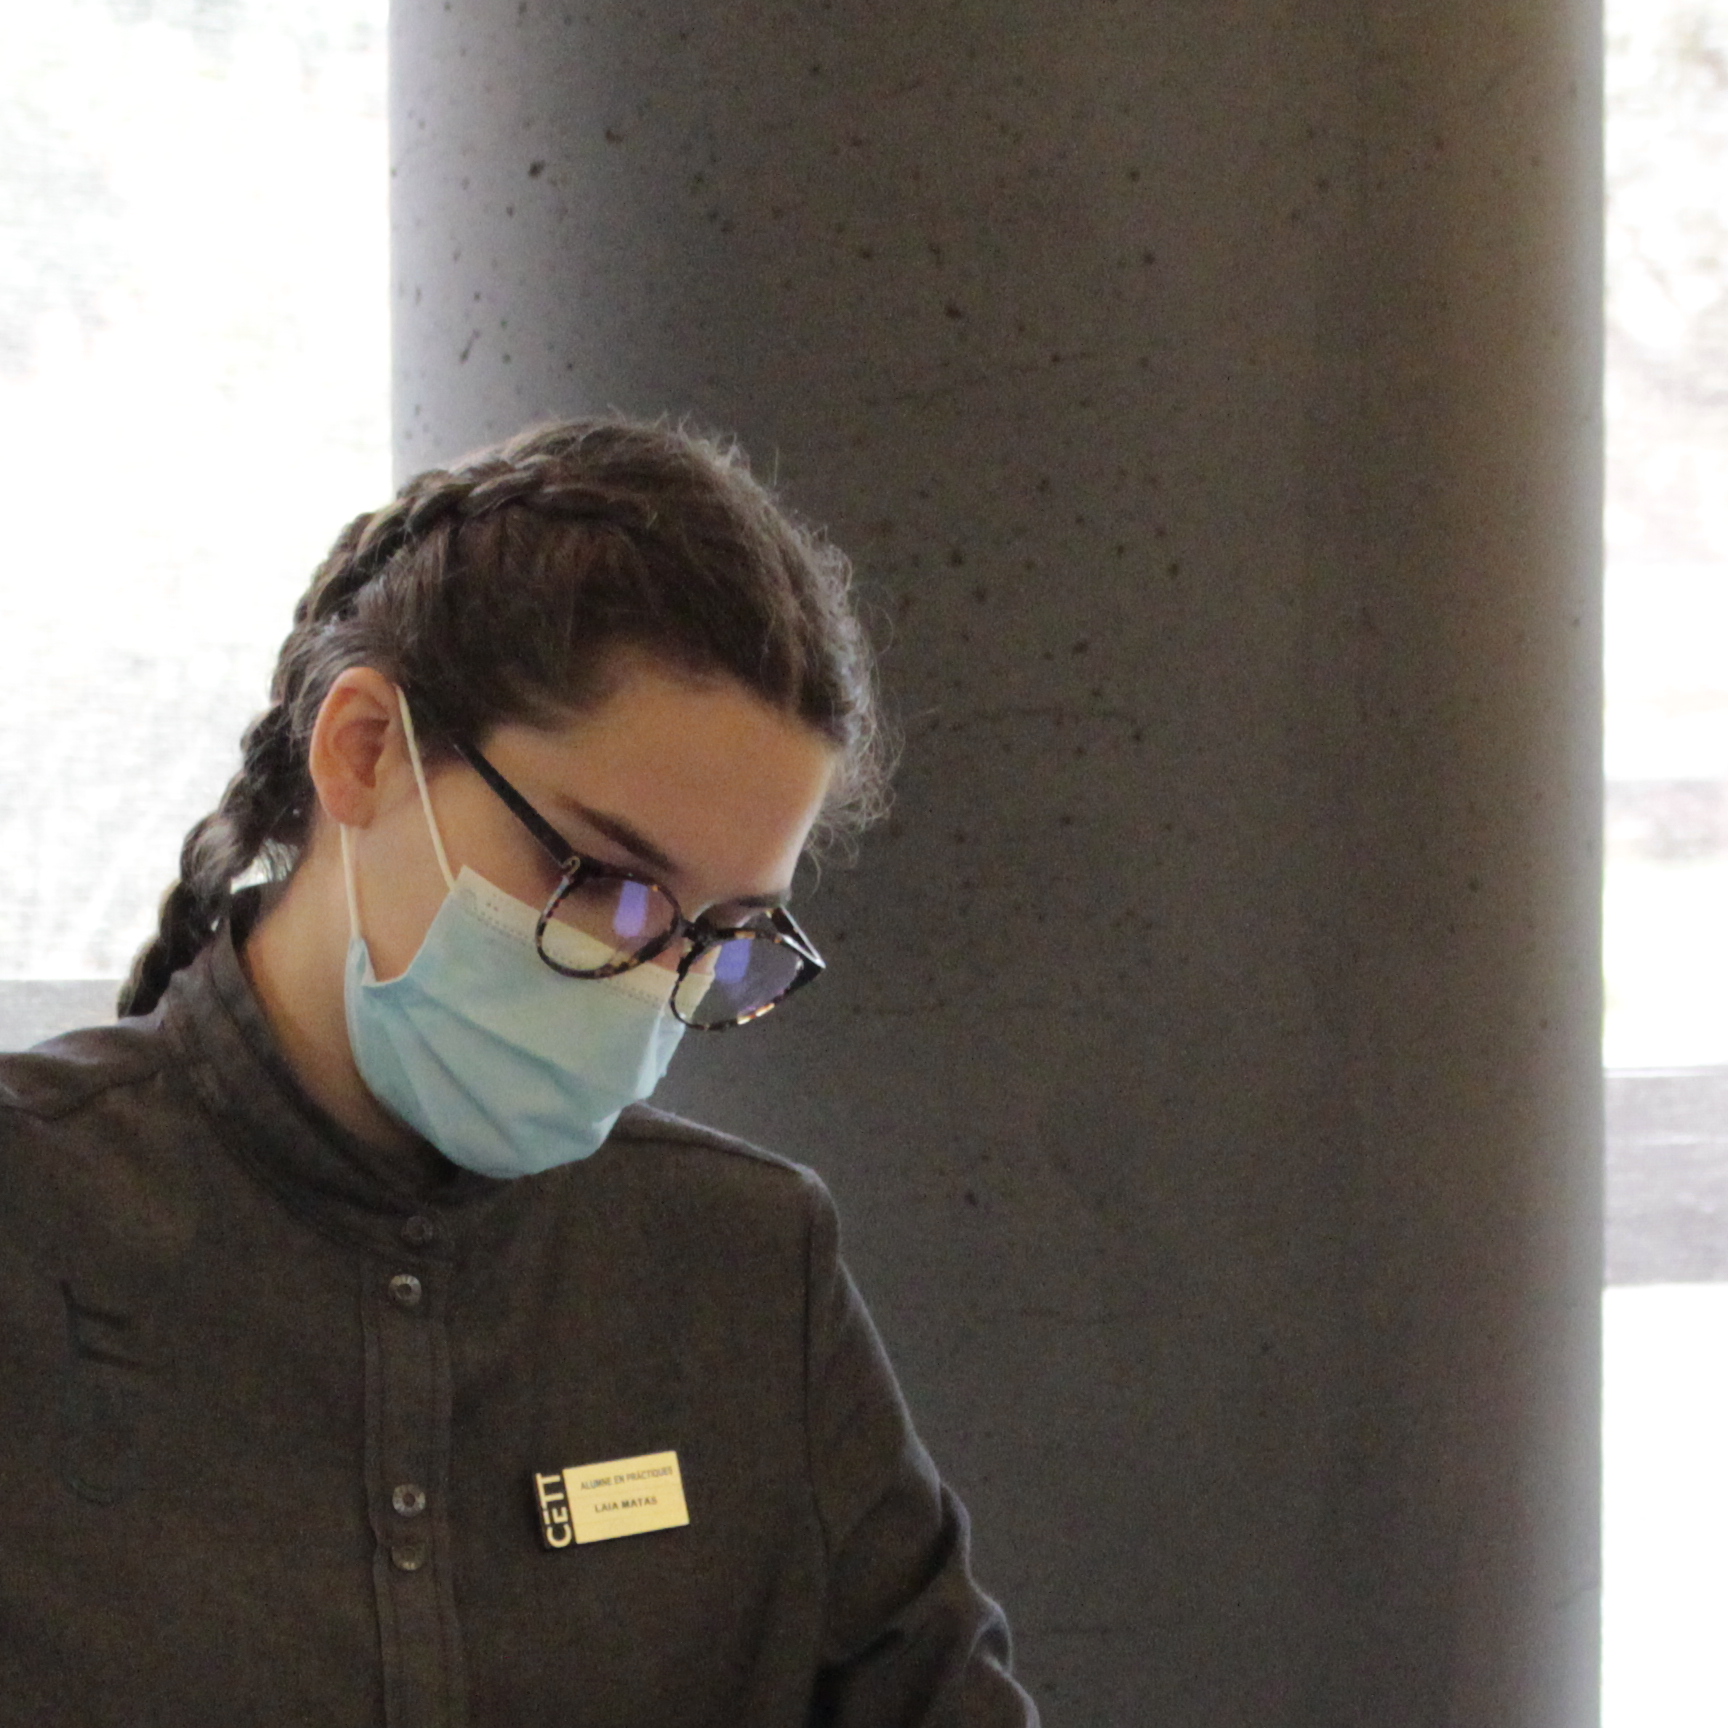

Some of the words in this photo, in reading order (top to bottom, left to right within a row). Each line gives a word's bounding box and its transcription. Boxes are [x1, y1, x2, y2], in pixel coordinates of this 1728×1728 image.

[580, 1476, 613, 1490] ALUMNE
[614, 1474, 625, 1486] EN
[535, 1472, 572, 1548] CETT
[594, 1501, 619, 1514] LAIA
